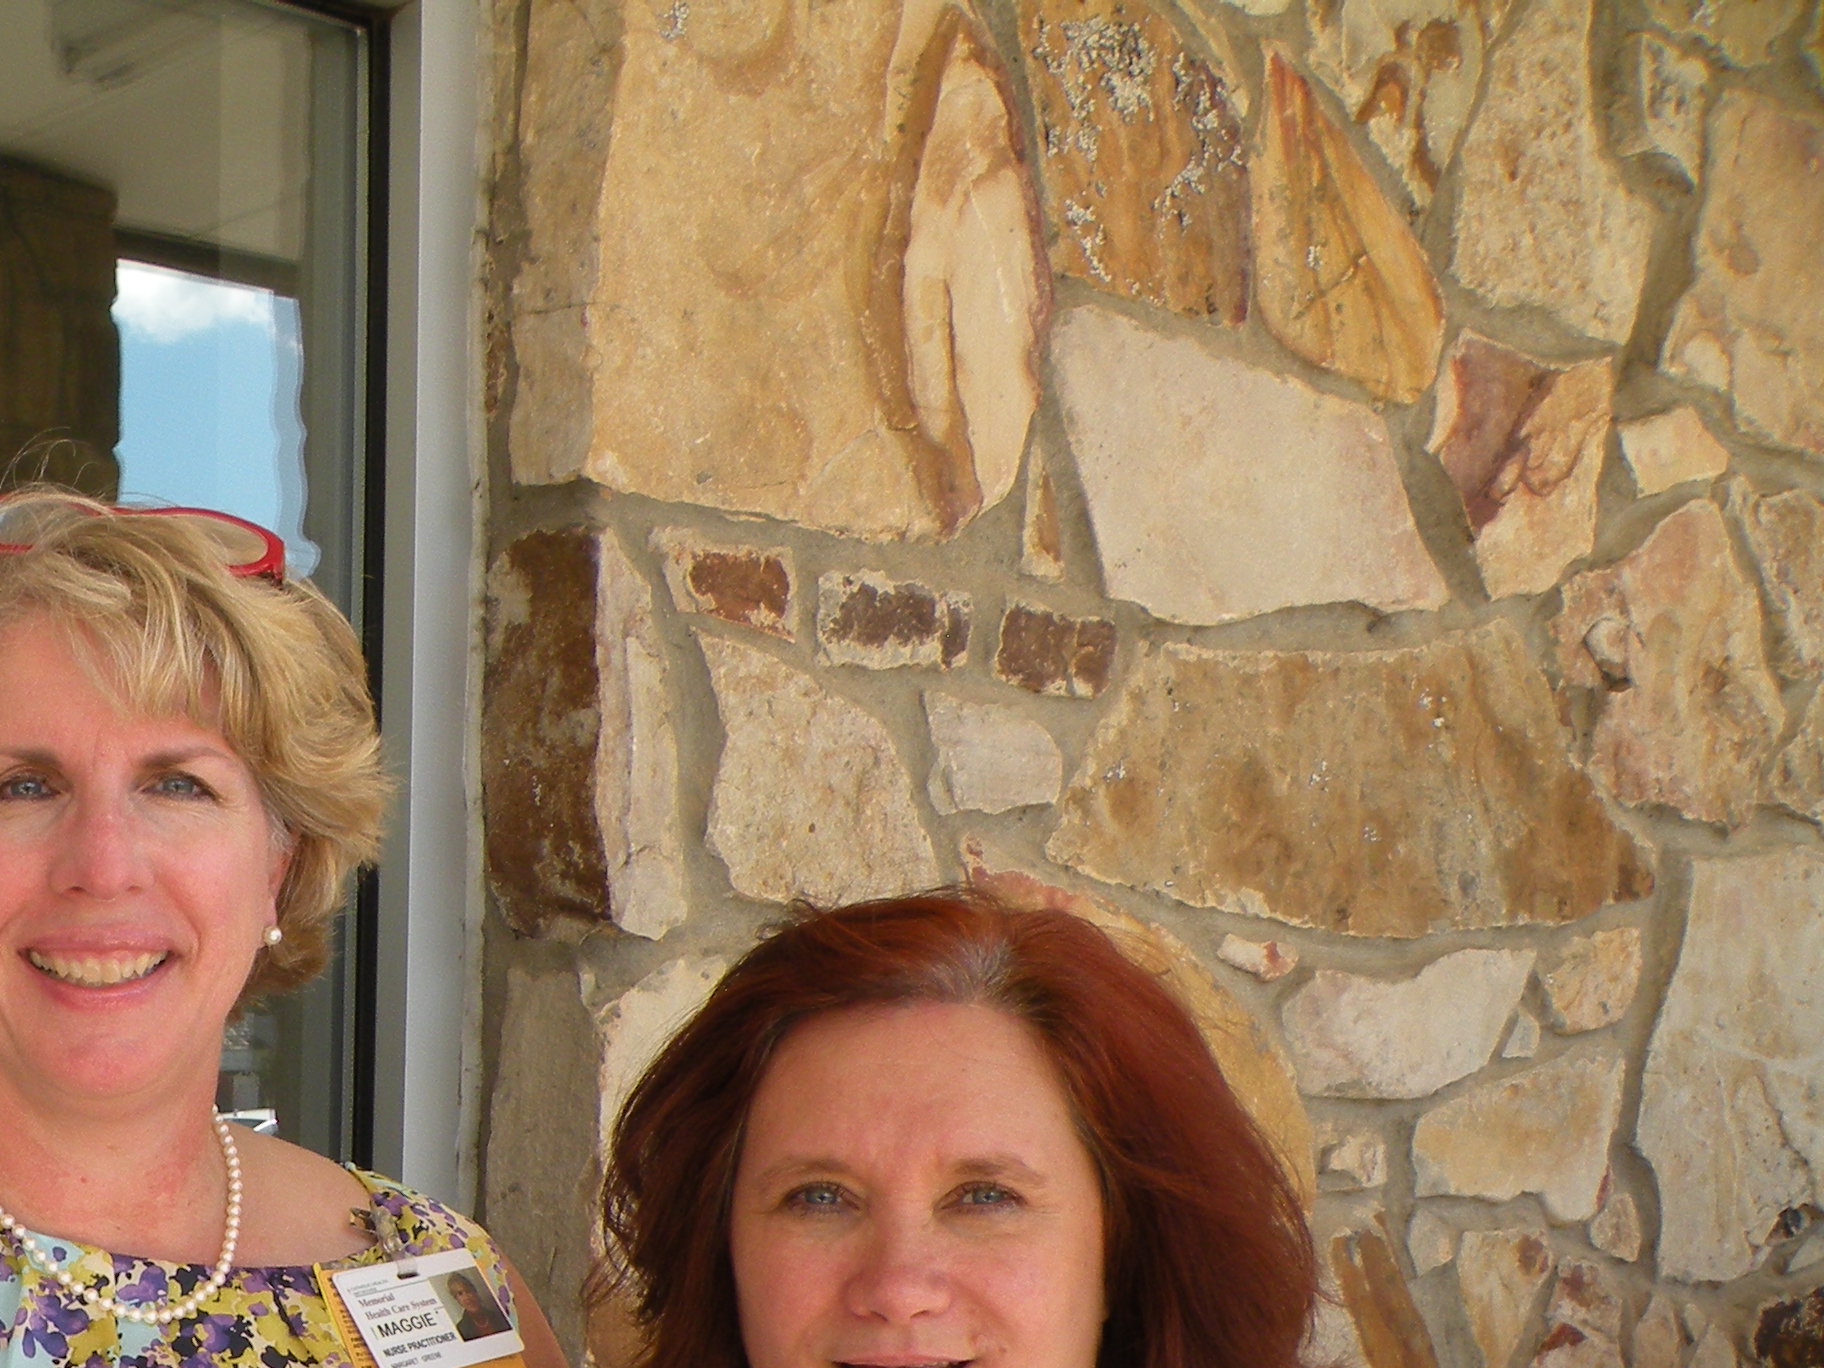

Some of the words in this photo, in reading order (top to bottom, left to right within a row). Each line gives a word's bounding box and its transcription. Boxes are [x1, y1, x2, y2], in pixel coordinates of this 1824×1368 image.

[358, 1293, 395, 1307] Memorial
[365, 1307, 392, 1320] Health
[391, 1303, 410, 1314] Care
[410, 1298, 437, 1310] System
[377, 1312, 438, 1338] MAGGIE
[383, 1344, 408, 1357] NURSE
[407, 1332, 457, 1351] PRACTITIONER
